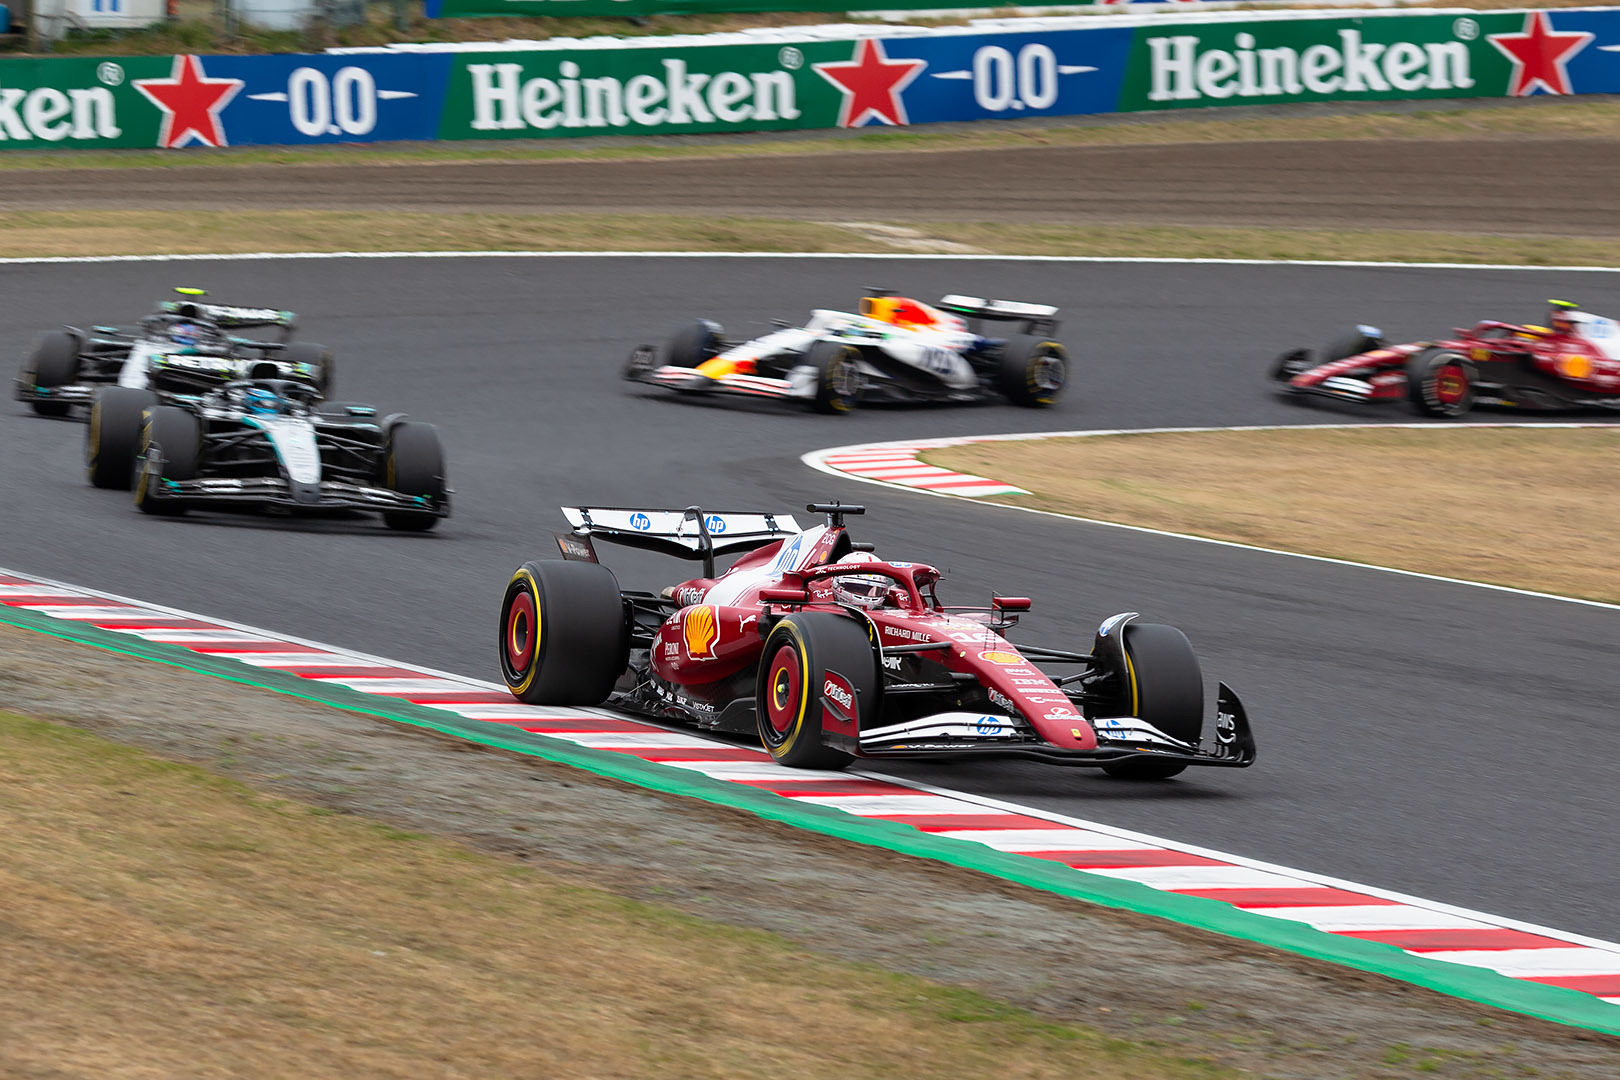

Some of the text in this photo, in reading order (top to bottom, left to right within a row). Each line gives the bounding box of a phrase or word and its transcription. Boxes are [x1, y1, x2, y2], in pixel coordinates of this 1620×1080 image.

[1146, 29, 1476, 102] Heineken
[467, 59, 800, 130] Heineken
[631, 513, 650, 530] hp
[706, 516, 725, 533] hp
[884, 625, 911, 639] RICHARD
[911, 631, 931, 643] MILLE
